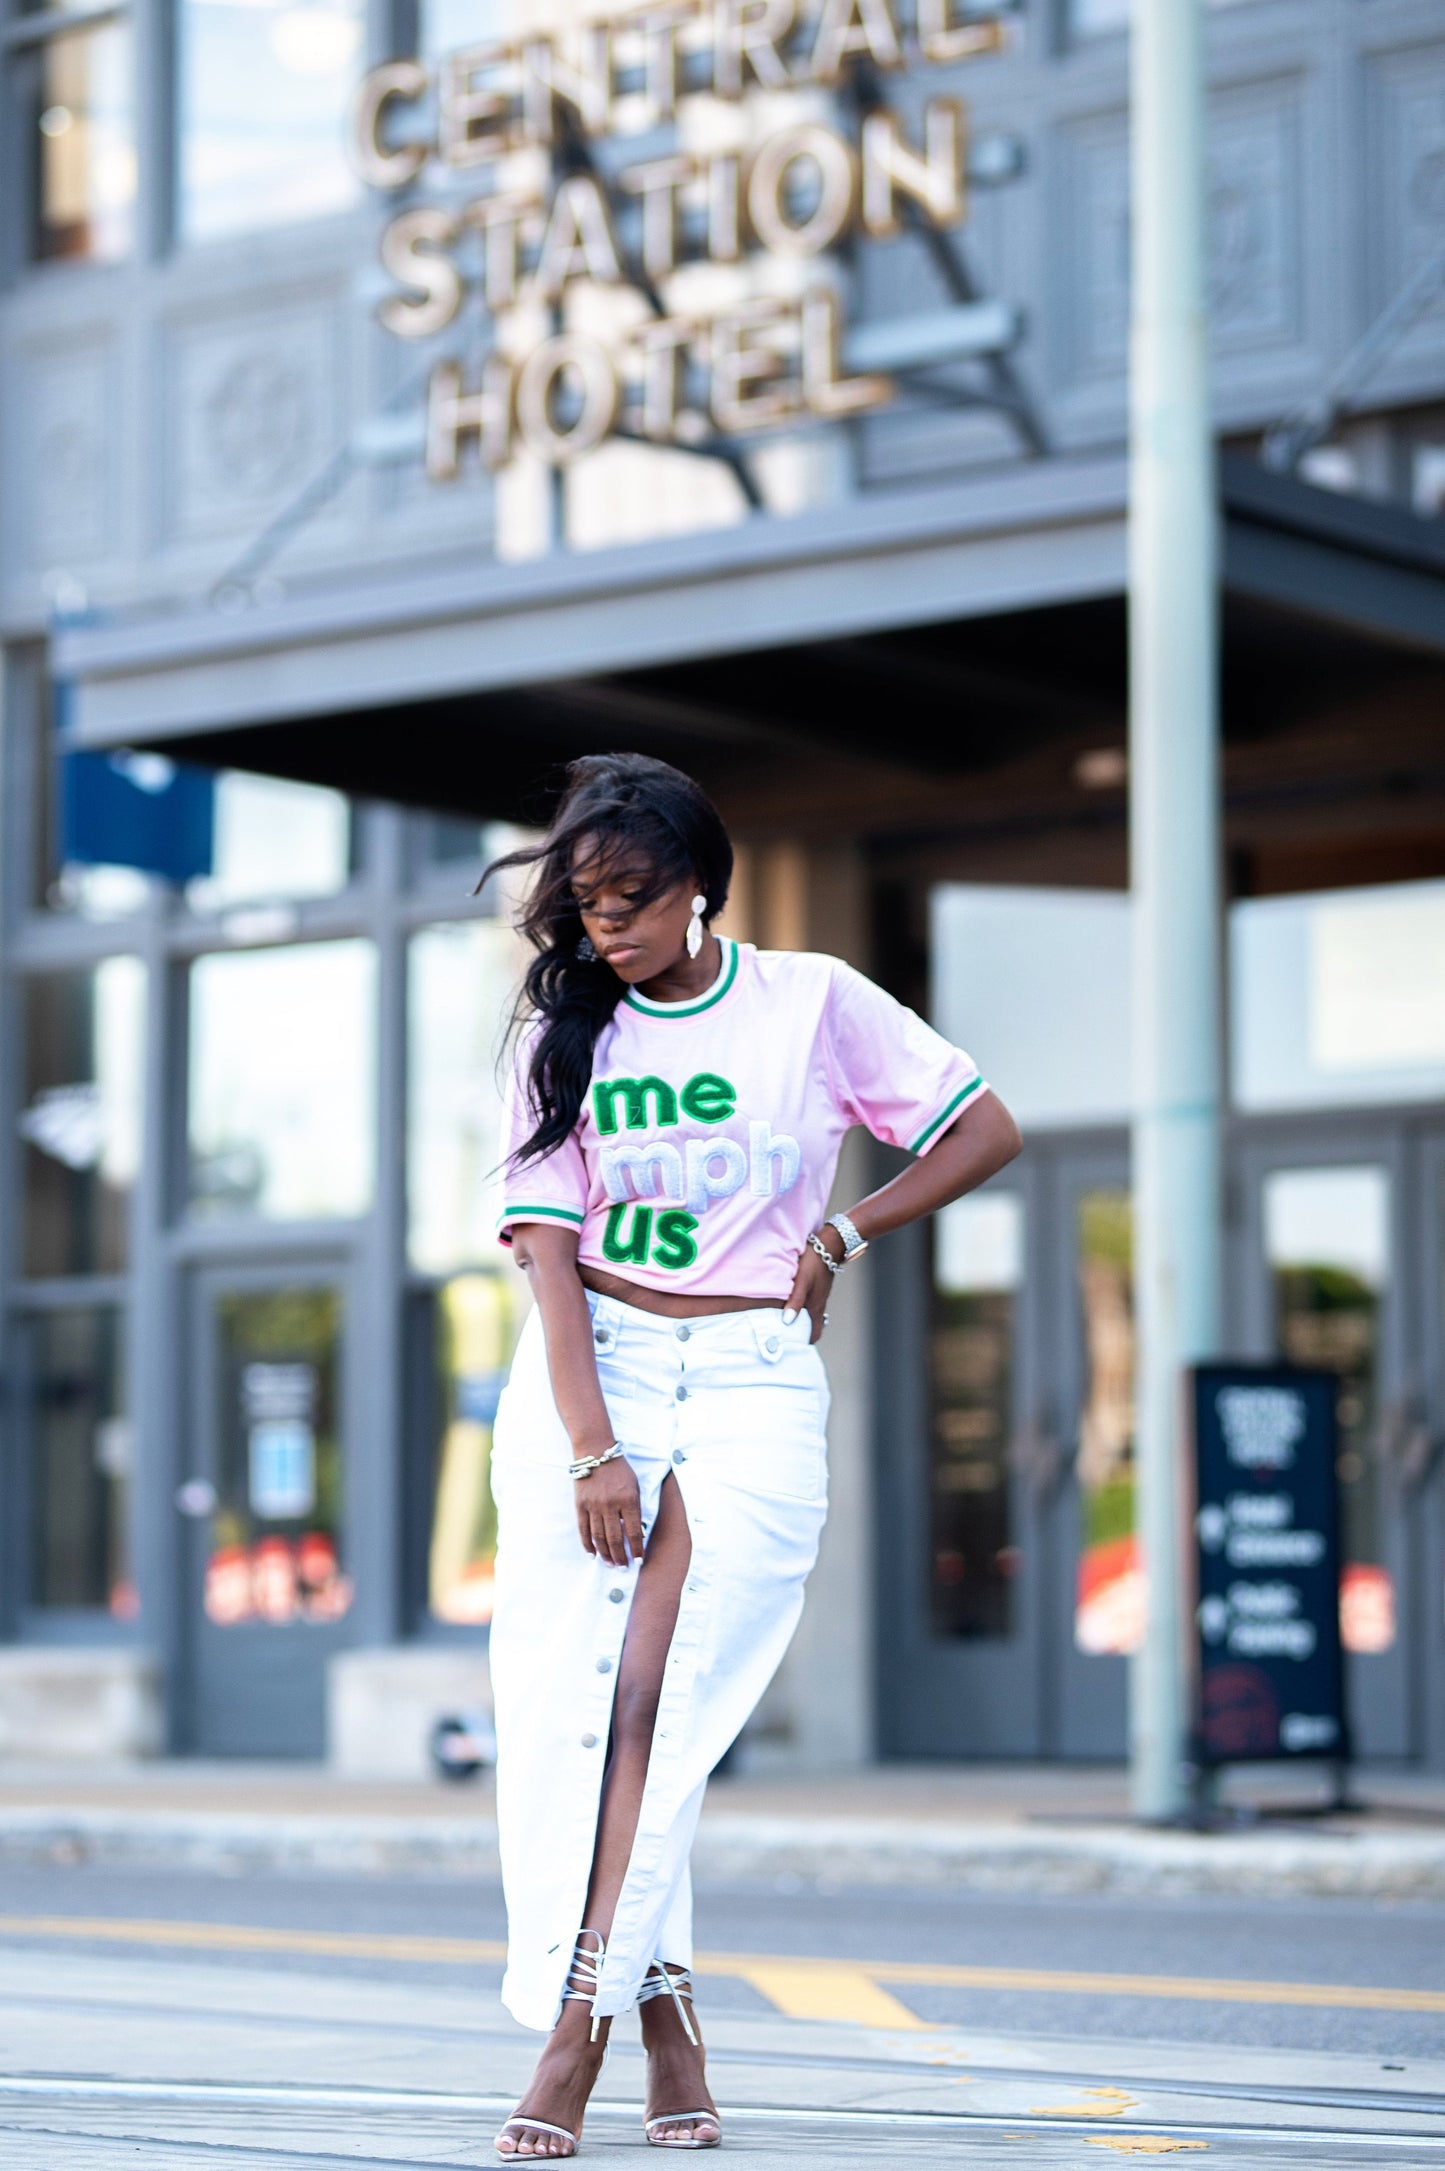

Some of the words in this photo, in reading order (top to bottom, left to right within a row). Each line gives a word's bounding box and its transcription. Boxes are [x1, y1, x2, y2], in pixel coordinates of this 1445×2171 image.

[378, 95, 968, 338] STATION
[425, 290, 891, 483] HOTEL
[592, 1072, 736, 1135] me
[601, 1120, 800, 1214] mph
[602, 1202, 699, 1269] us
